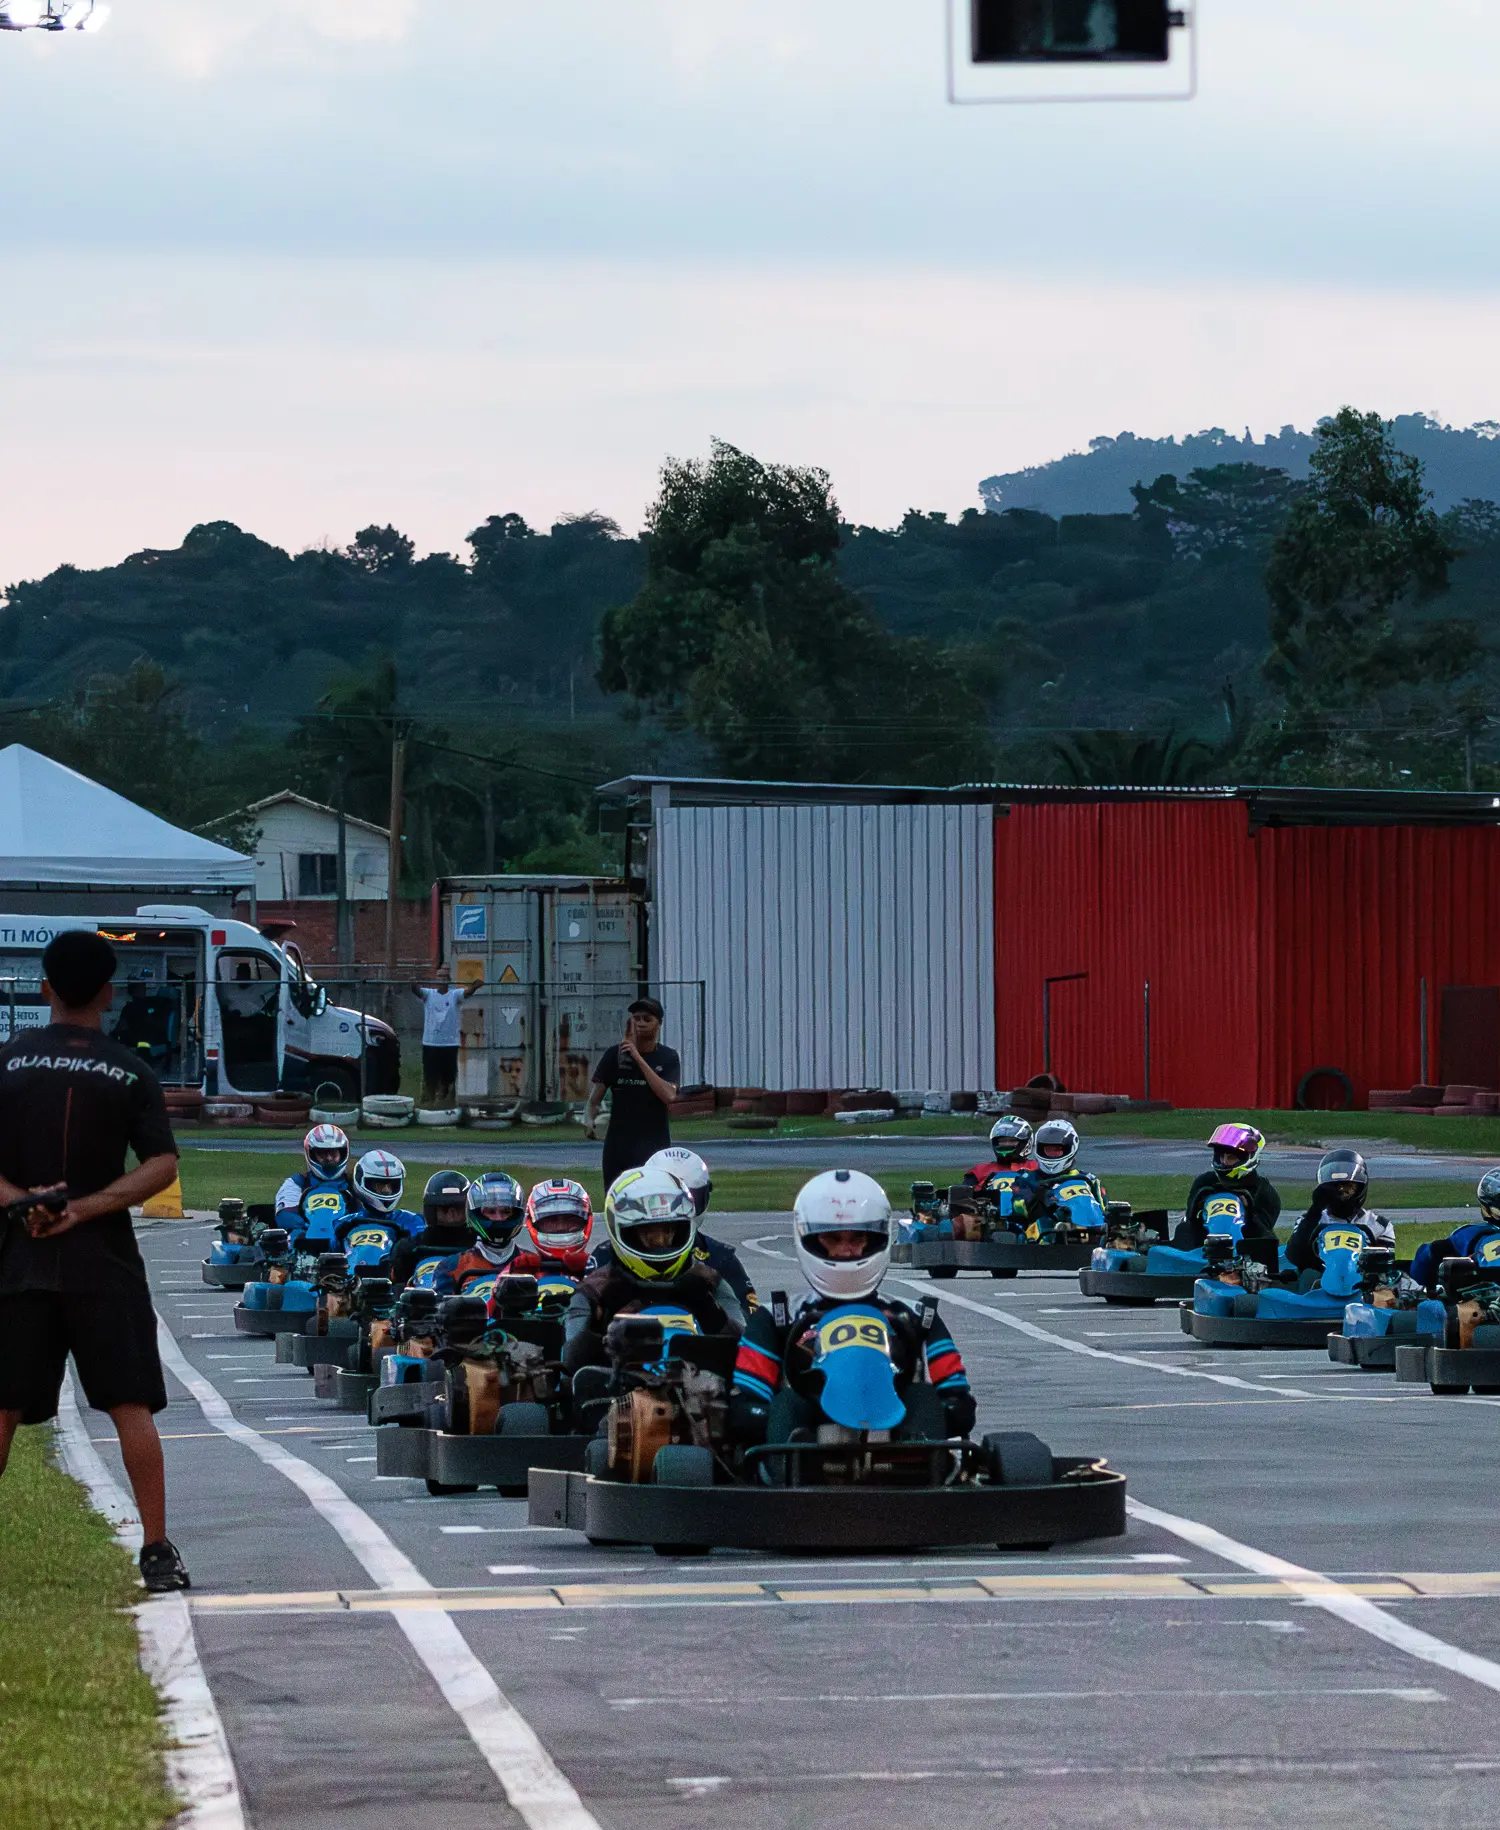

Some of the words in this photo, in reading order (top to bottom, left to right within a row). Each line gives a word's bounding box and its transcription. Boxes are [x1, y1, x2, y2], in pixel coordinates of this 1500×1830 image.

[7, 1055, 139, 1086] GUAPIKART
[312, 1197, 338, 1208] 20
[1210, 1202, 1238, 1215] 26
[354, 1233, 383, 1244] 29
[1330, 1235, 1360, 1249] 15
[829, 1323, 886, 1346] 09
